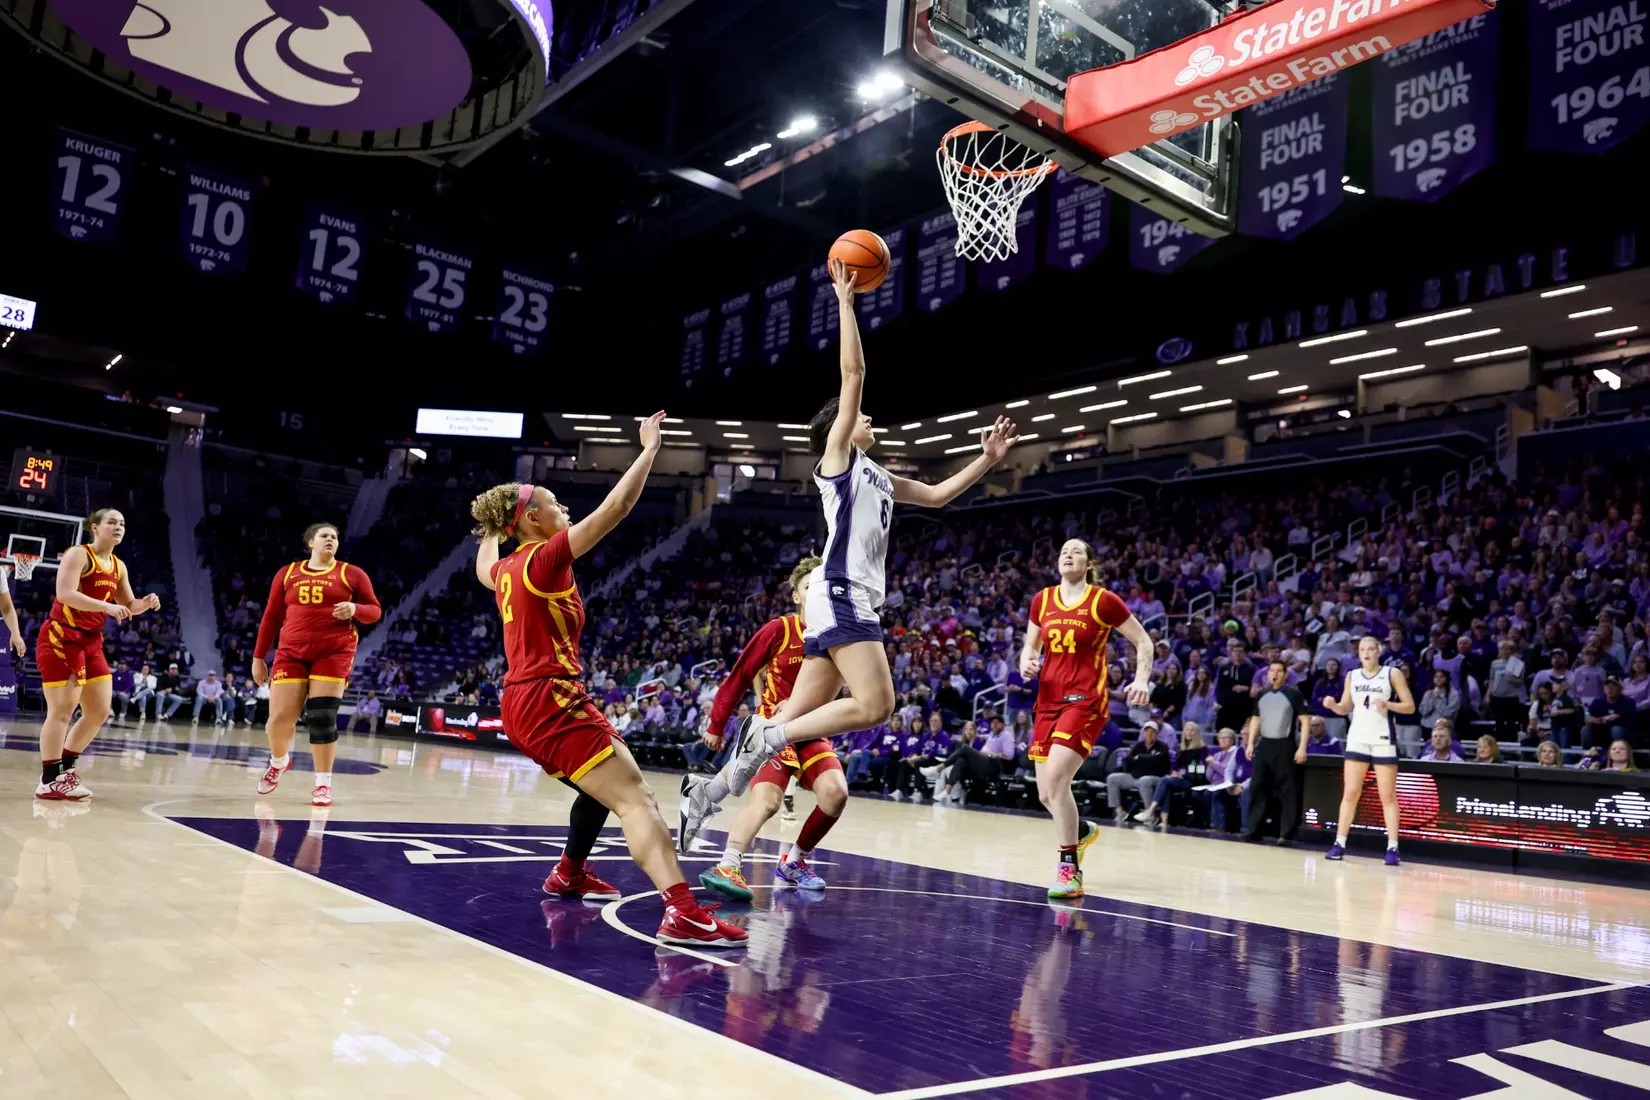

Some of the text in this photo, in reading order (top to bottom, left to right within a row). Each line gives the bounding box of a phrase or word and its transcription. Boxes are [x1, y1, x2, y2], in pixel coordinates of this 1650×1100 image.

[1556, 0, 1647, 49] FINAL
[1556, 23, 1645, 73] FOUR
[1394, 61, 1472, 105] FINAL
[1550, 65, 1650, 125] 1964
[1394, 83, 1469, 126] FOUR
[1261, 112, 1325, 151] FINAL
[65, 137, 121, 163] KRUGER
[1260, 131, 1323, 171] FOUR
[1388, 123, 1477, 173] 1958
[57, 155, 121, 215] 12
[190, 173, 251, 201] WILLIAMS
[1257, 169, 1327, 213] 1951
[58, 207, 104, 229] 1971-74
[187, 192, 245, 246] 10
[319, 213, 357, 234] EVANS
[1139, 219, 1196, 248] 194
[189, 242, 231, 262] 1972-76
[309, 228, 361, 281] 12
[415, 243, 472, 269] BLACKMAN
[412, 260, 466, 309] 25
[502, 269, 554, 293] RICHMOND
[500, 285, 549, 333] 23
[1231, 288, 1388, 349] KANSAS
[1421, 246, 1570, 309] STATE
[1, 306, 25, 322] 28
[19, 468, 47, 489] 24
[27, 457, 53, 471] 8:49
[880, 498, 889, 529] 6
[293, 579, 333, 588] IOWA STATE
[298, 585, 323, 604] 55
[500, 572, 514, 625] 2
[1045, 618, 1087, 629] IOWA STATE
[1048, 628, 1076, 654] 24
[788, 656, 803, 665] IOW
[1355, 684, 1384, 693] Wildcats
[1363, 695, 1370, 709] 4
